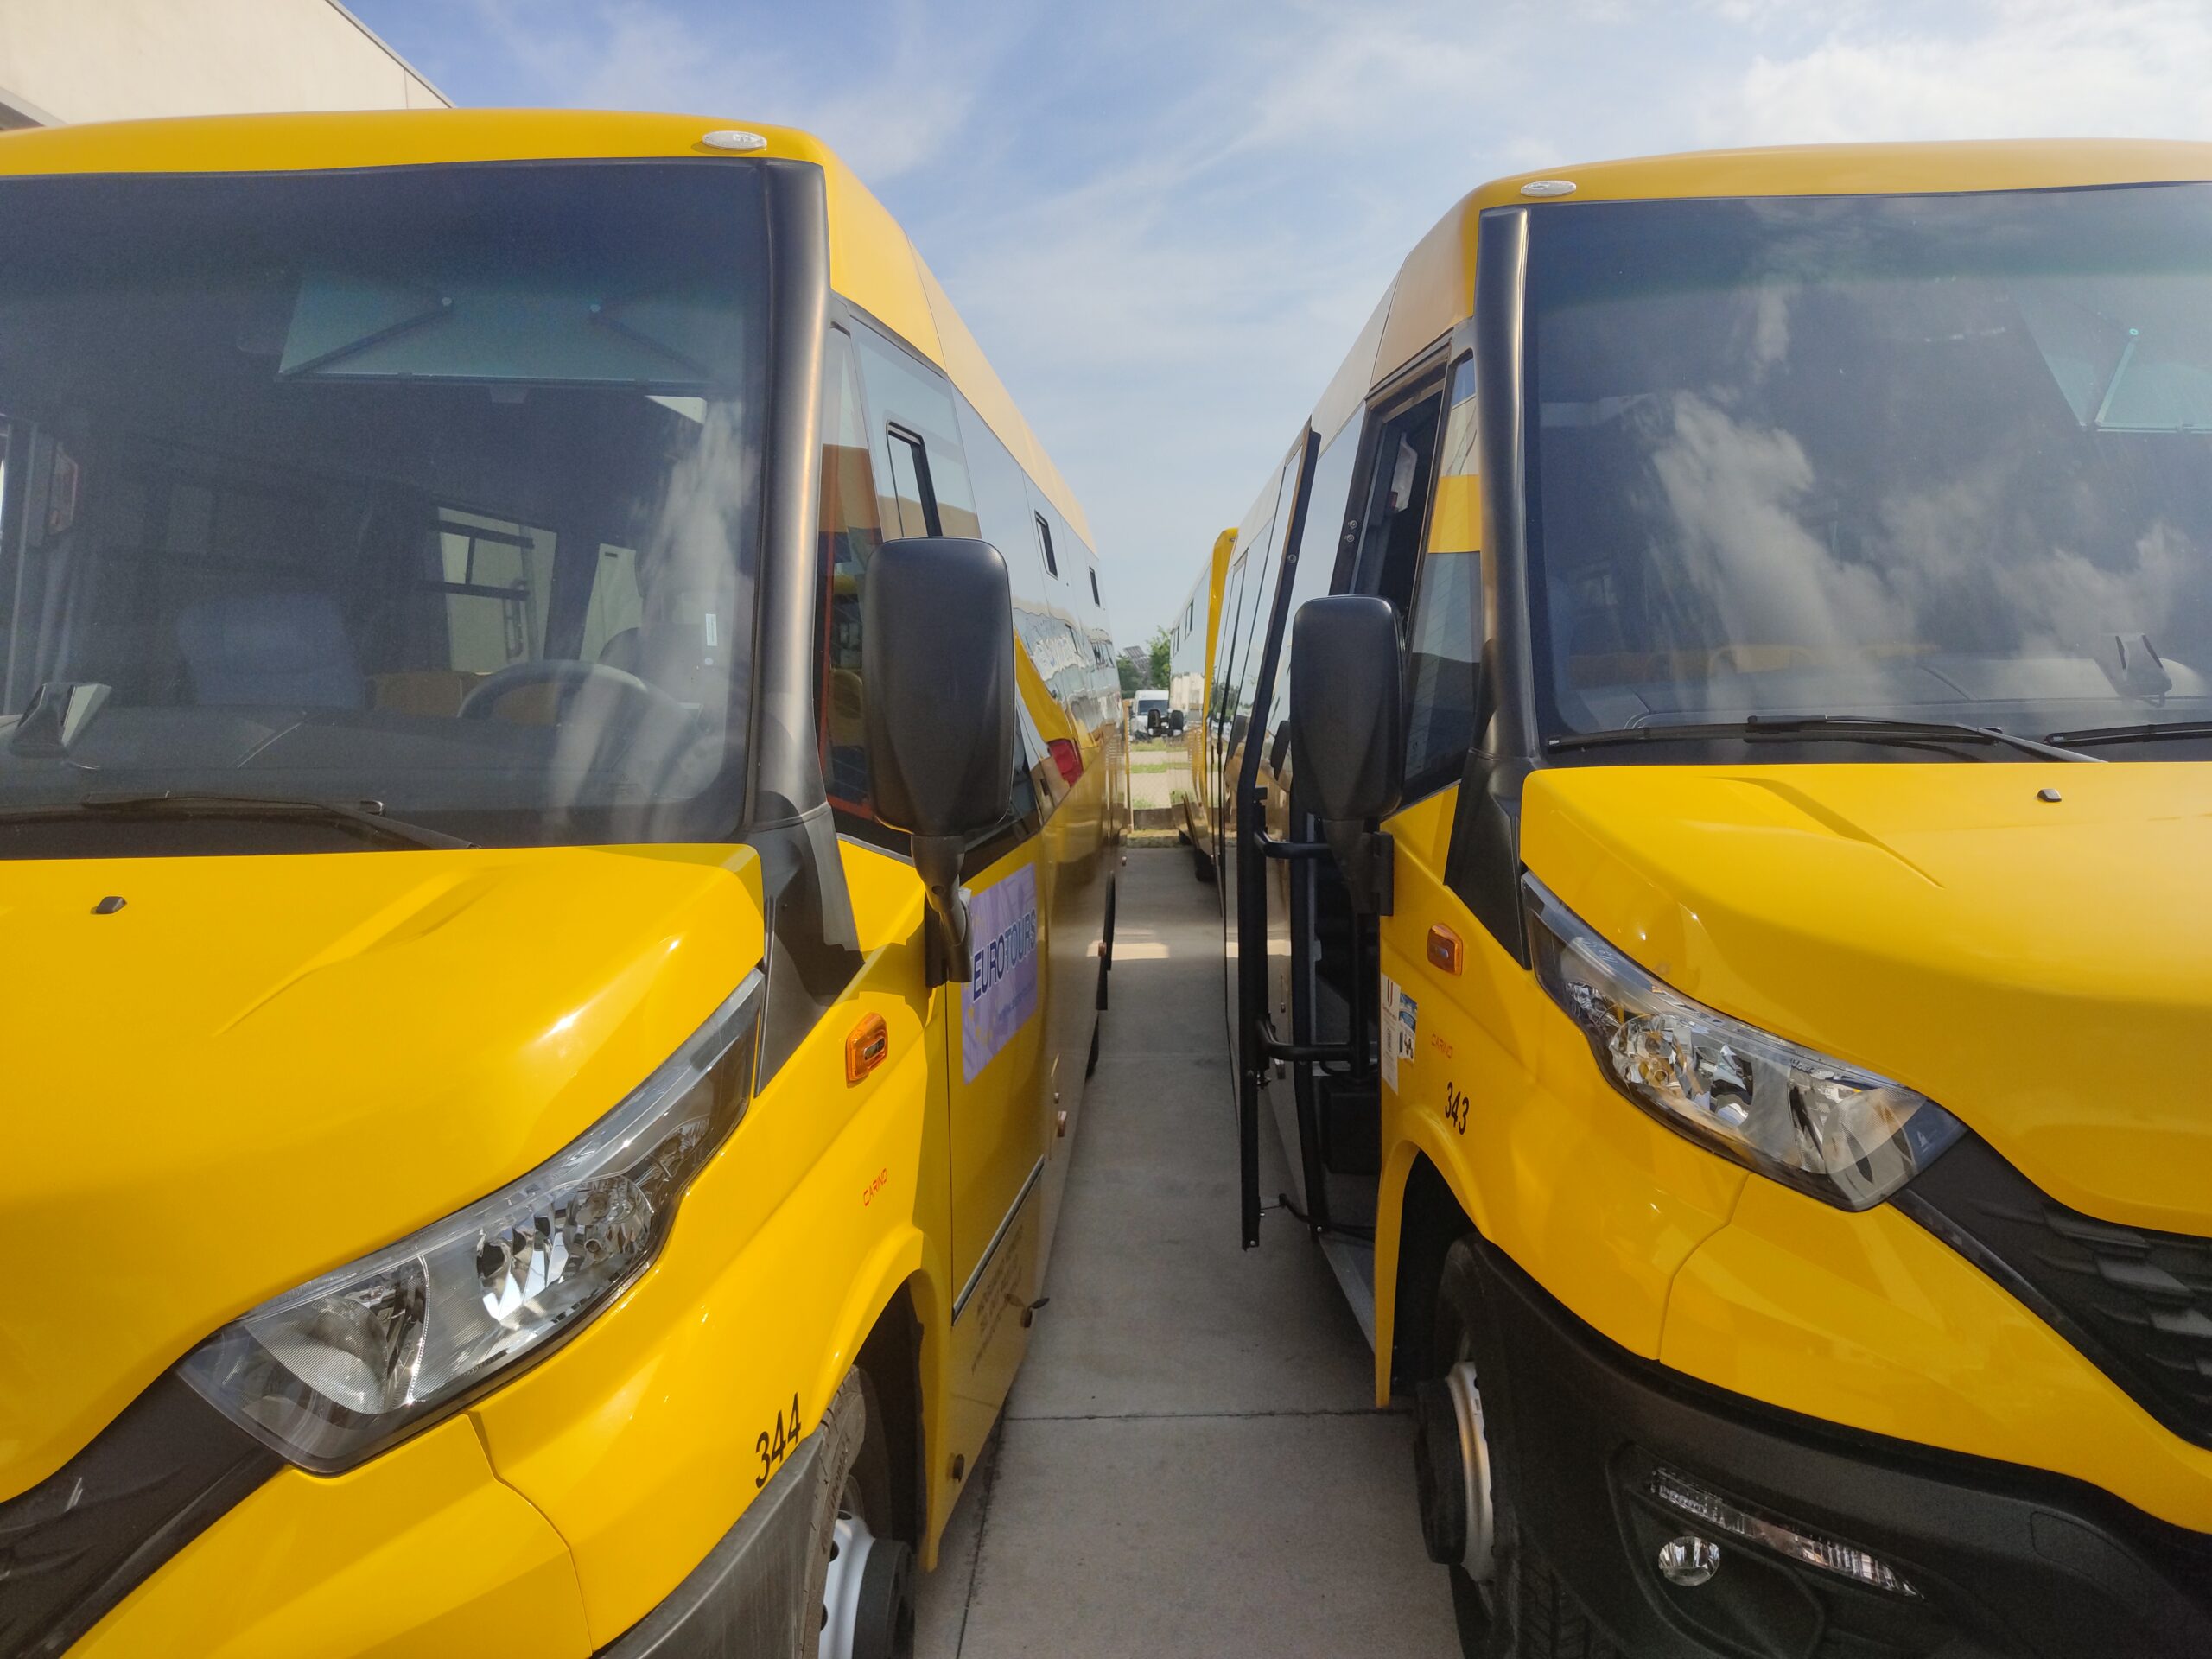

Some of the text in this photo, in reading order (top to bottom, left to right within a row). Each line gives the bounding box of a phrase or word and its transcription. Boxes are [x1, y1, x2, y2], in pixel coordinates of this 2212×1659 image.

[973, 909, 1036, 1001] EUROTOURS
[1445, 1081, 1470, 1135] 343
[755, 1392, 801, 1488] 344
